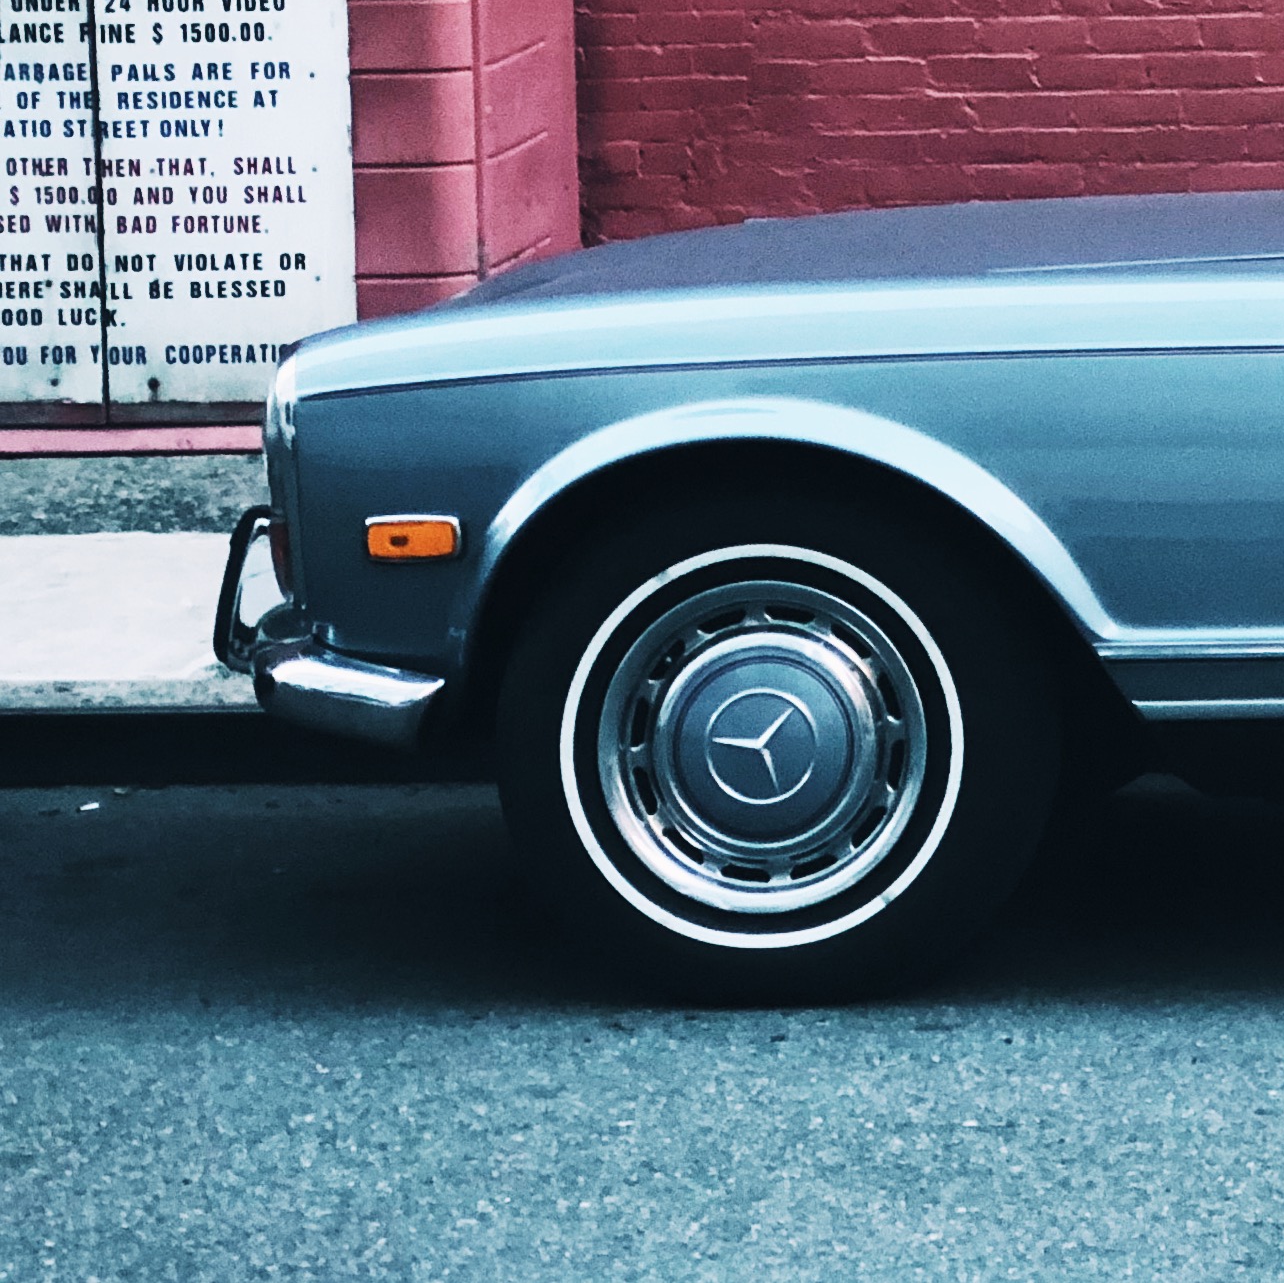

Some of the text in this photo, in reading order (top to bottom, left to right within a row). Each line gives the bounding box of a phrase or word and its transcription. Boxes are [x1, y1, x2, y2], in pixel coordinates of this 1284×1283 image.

[79, 22, 136, 44] FINE
[152, 22, 163, 45] $
[180, 22, 273, 43] 1500.00.
[110, 63, 175, 83] PAILS
[192, 62, 232, 81] ARE
[251, 61, 291, 81] FOR
[16, 89, 279, 110] OF THE RESIDENCE AT
[4, 119, 52, 138] ATIO
[63, 119, 149, 139] STREET
[6, 157, 68, 177] OTHER
[83, 157, 141, 177] THEN
[233, 154, 297, 176] SHALL
[10, 185, 307, 206] $ 1500.00 AND YOU SHALL
[45, 214, 97, 234] WITH
[116, 215, 157, 235] BAD
[171, 215, 269, 234] FORTUNE.
[0, 253, 306, 273] THAT DO NOT VIOLATE OR
[0, 279, 286, 300] ERE SHALL BE BLESSED
[40, 345, 77, 366] FOR
[90, 344, 147, 366] YOUR
